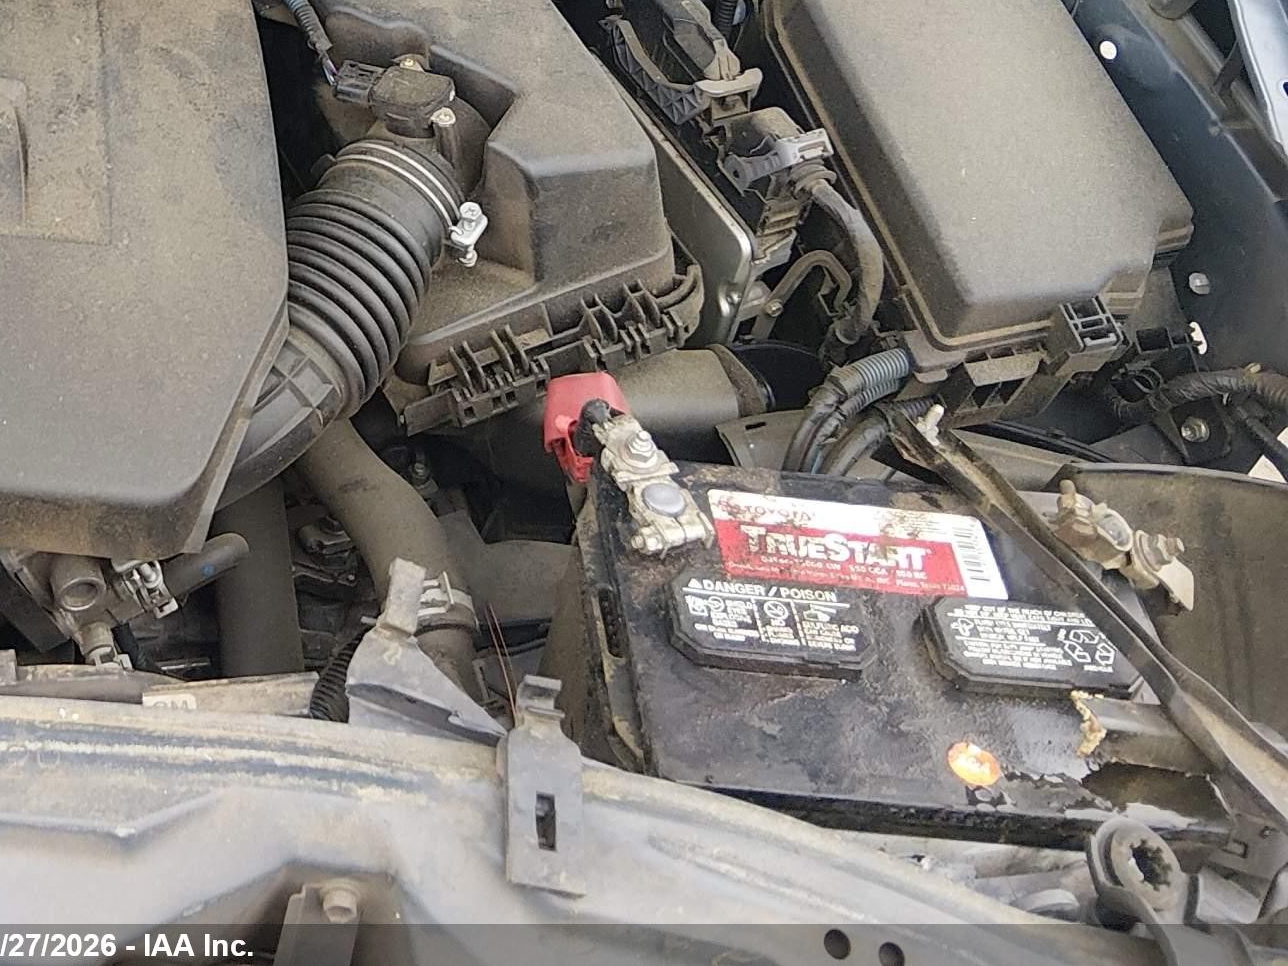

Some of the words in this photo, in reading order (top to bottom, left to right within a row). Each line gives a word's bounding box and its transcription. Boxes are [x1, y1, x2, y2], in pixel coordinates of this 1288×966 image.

[744, 505, 811, 522] TOYOTA
[703, 579, 766, 596] DANGER
[780, 587, 838, 602] POISON
